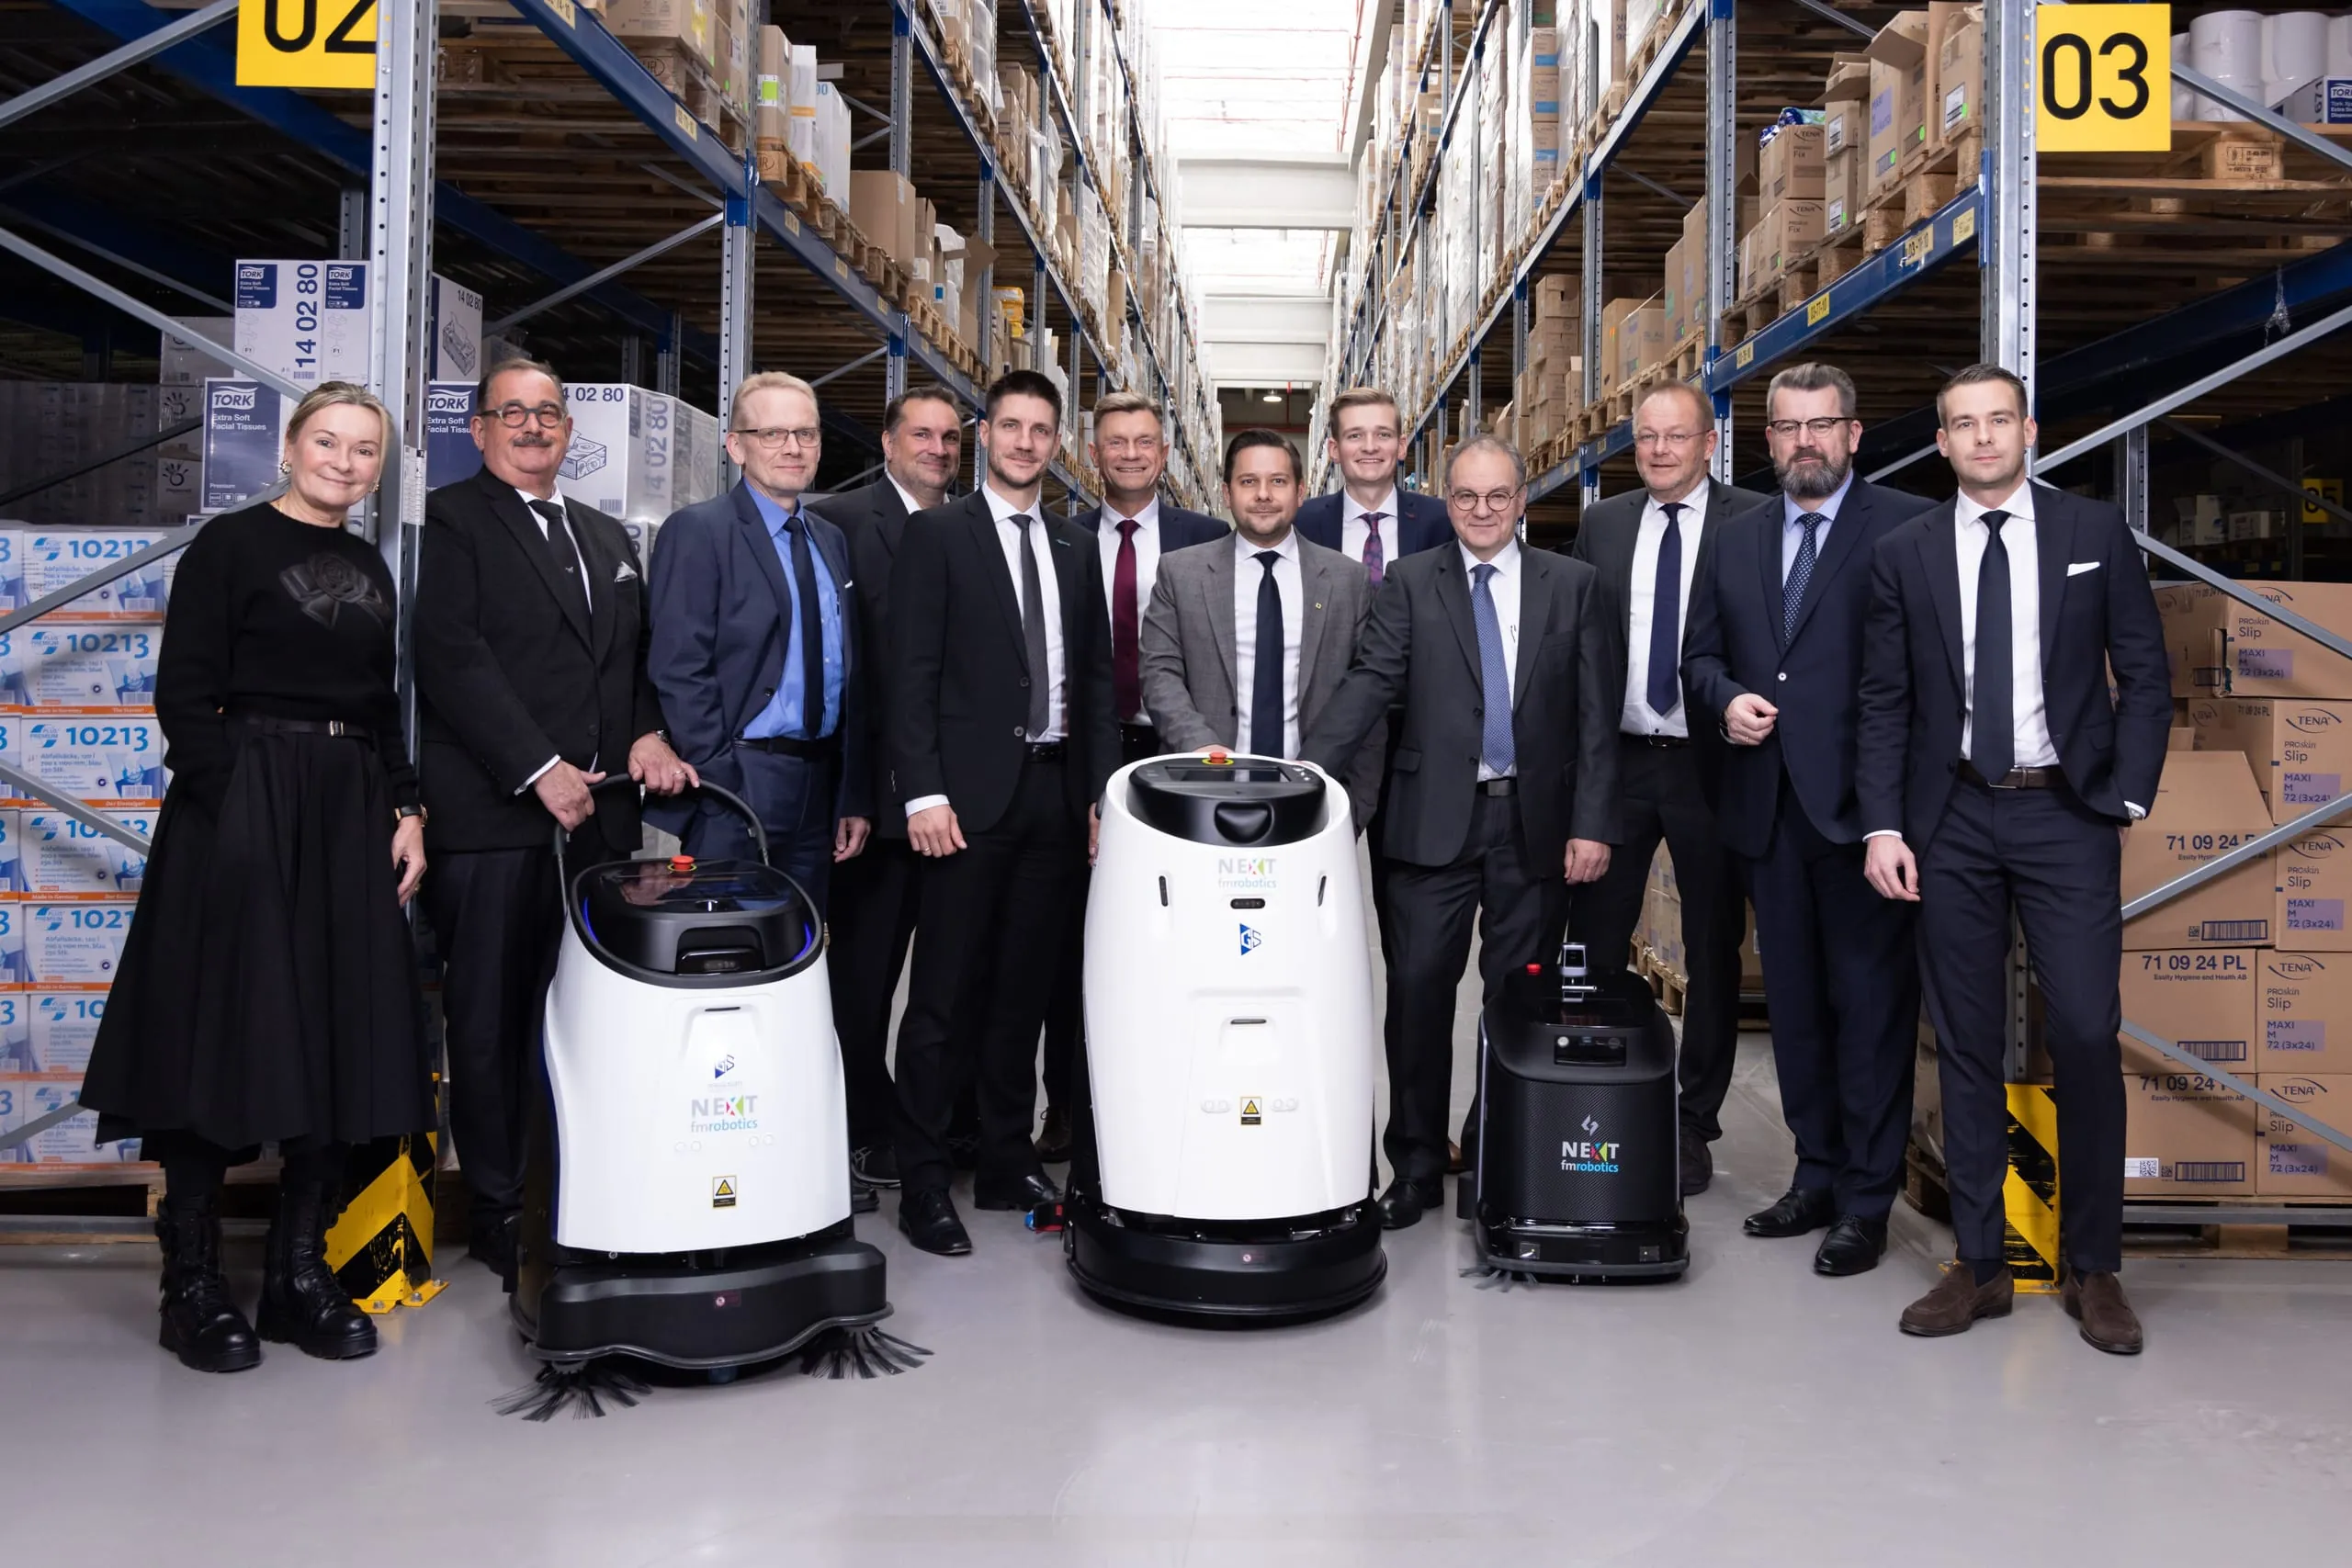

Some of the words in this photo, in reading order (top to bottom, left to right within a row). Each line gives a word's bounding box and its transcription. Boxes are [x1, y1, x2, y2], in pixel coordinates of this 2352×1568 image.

[265, 0, 377, 53] 02
[2042, 32, 2149, 120] 03
[297, 264, 318, 294] 80
[458, 289, 466, 302] 14
[466, 293, 474, 307] 02
[296, 301, 317, 332] 02
[295, 339, 316, 367] 14
[214, 394, 253, 405] TORK
[575, 388, 596, 401] 02
[603, 388, 624, 401] 80
[429, 398, 466, 410] TORK
[2239, 626, 2262, 639] Slip
[67, 634, 149, 659] 10213
[2239, 649, 2265, 657] MAXI
[2253, 669, 2284, 678] (3x24)
[2297, 716, 2329, 726] TENA
[66, 727, 149, 751] 10213
[2284, 740, 2316, 749] PROskin
[2285, 750, 2308, 763] Slip
[2284, 773, 2311, 782] MAXI
[2166, 835, 2186, 850] 71
[2192, 835, 2213, 850] 09
[2218, 835, 2239, 849] 24
[2301, 841, 2332, 851] TENA
[1218, 858, 1276, 875] NEXT
[2288, 865, 2319, 874] PROskin
[1218, 877, 1277, 889] fmrobotics
[2288, 876, 2312, 889] Slip
[2288, 919, 2300, 928] 72
[2301, 919, 2335, 929] (3x24)
[2142, 955, 2161, 970] 71
[2169, 955, 2190, 970] 09
[2196, 955, 2218, 970] 24
[2223, 955, 2247, 970] PL
[2279, 963, 2312, 972] TENA
[2267, 987, 2300, 996] PROskin
[2267, 998, 2291, 1011] Slip
[2267, 1041, 2279, 1049] 72
[2282, 1042, 2315, 1050] (3x24)
[2140, 1076, 2159, 1090] 71
[2166, 1076, 2188, 1091] 09
[2193, 1076, 2215, 1090] 24
[2282, 1086, 2314, 1095] TENA
[691, 1095, 758, 1118] NEXT
[690, 1118, 758, 1134] fmrobotics
[2270, 1121, 2294, 1134] Slip
[1562, 1141, 1620, 1162] NEXT
[1561, 1160, 1619, 1173] fmrobotics
[2285, 1165, 2318, 1174] (3x24)
